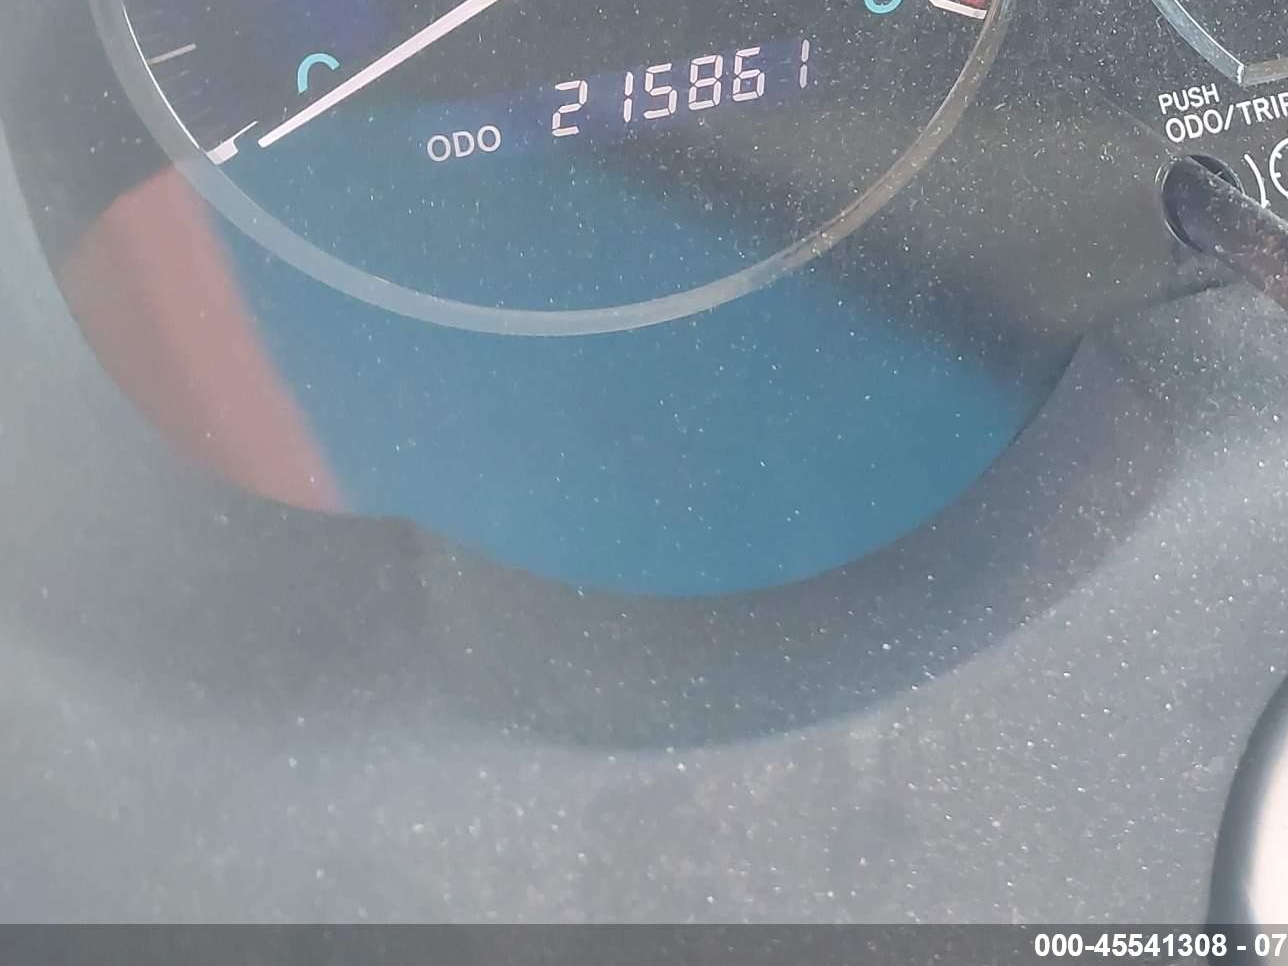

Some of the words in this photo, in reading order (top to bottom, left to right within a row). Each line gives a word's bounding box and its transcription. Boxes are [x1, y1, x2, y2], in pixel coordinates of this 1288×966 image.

[426, 124, 501, 162] ODO
[552, 39, 811, 137] 215861
[1158, 83, 1220, 115] PUSH
